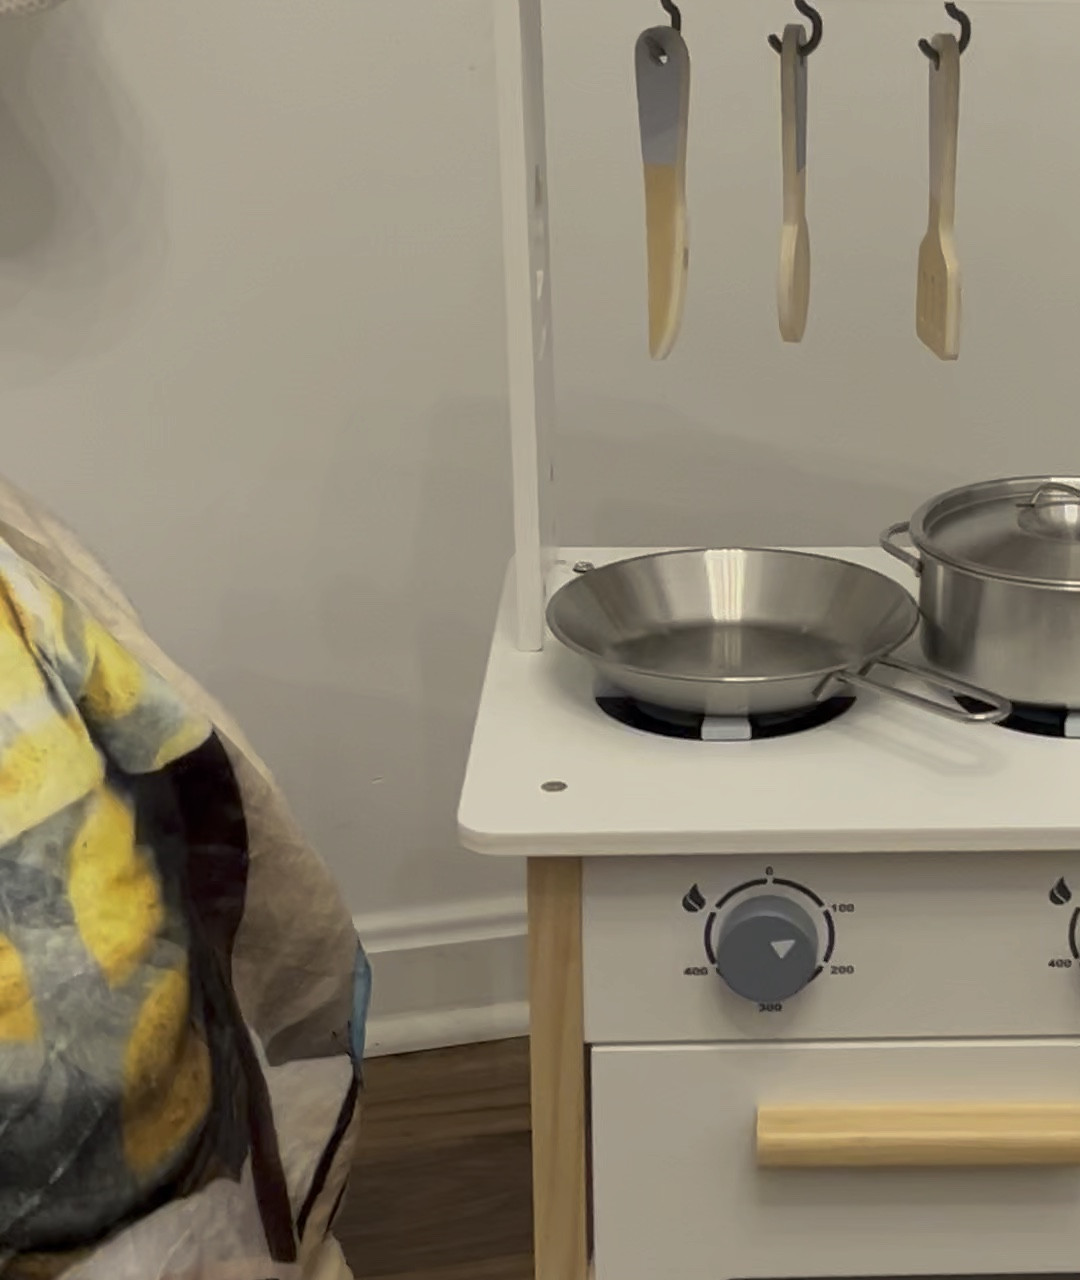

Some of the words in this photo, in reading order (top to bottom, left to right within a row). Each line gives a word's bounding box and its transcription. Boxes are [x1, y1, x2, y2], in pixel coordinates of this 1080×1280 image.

[831, 903, 855, 913] 100
[1048, 958, 1073, 968] 400
[683, 966, 709, 976] 400
[831, 965, 855, 975] 200
